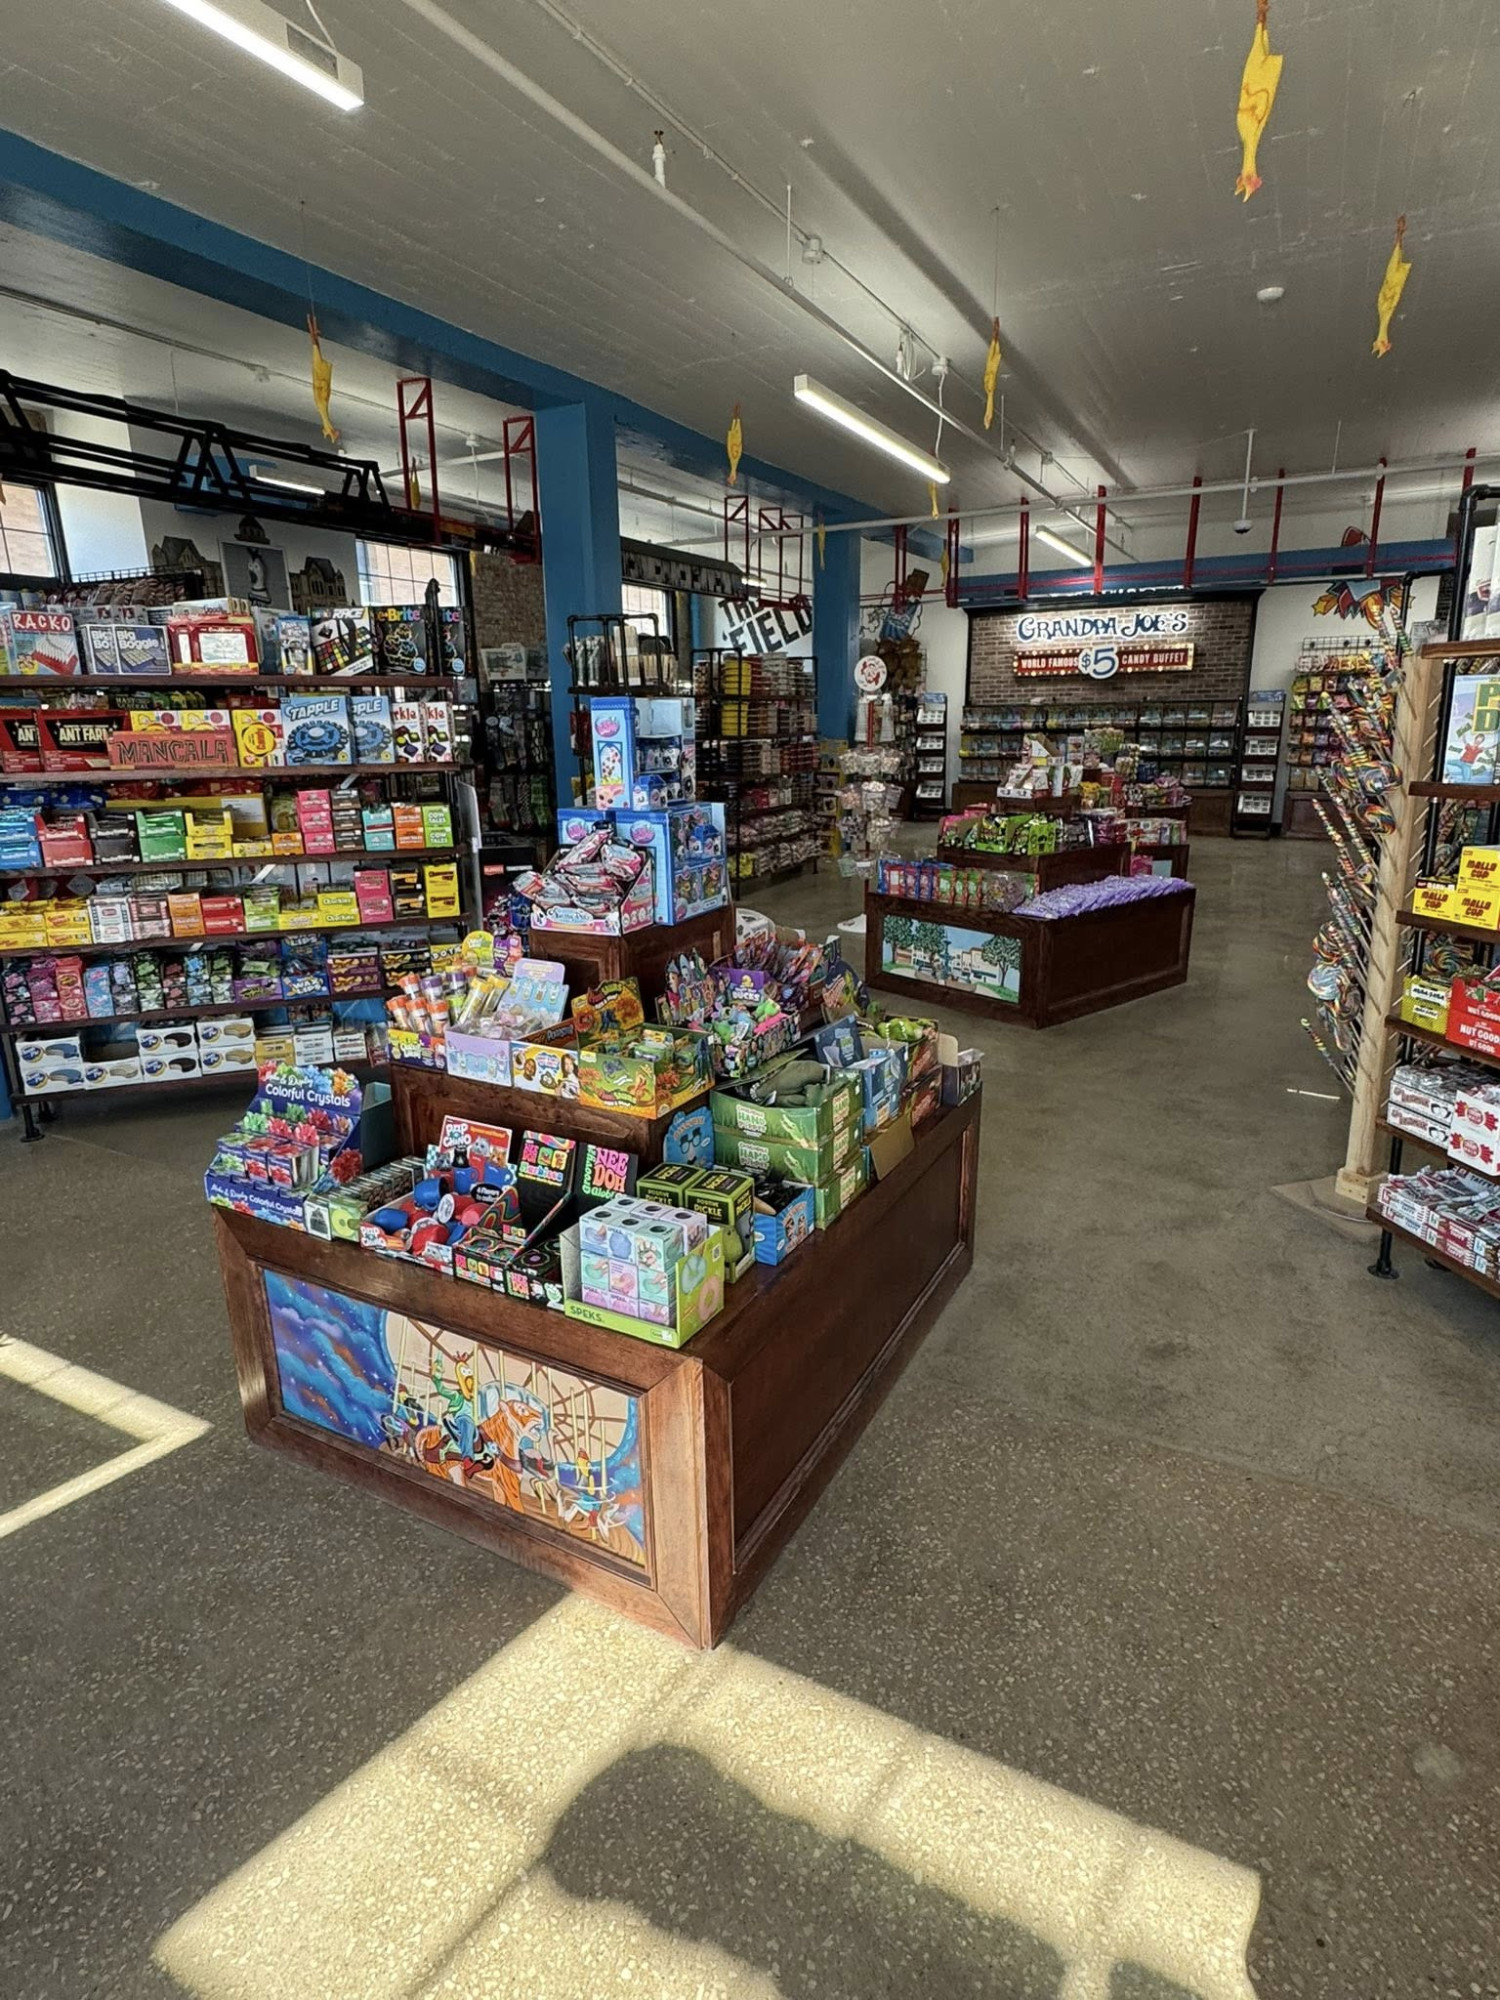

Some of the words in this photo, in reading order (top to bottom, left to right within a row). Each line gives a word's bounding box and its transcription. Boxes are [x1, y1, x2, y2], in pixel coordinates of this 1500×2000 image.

[332, 608, 364, 619] RACE
[1017, 616, 1117, 641] GRANDPA
[1121, 612, 1188, 637] JOE'S
[117, 630, 137, 642] Big
[119, 637, 159, 651] Boggle
[1021, 659, 1047, 669] WORLD
[1048, 657, 1078, 668] FAMOUS
[1081, 646, 1116, 677] $5
[1121, 654, 1150, 665] CANDY
[1152, 652, 1185, 664] BUFFET
[290, 698, 339, 721] TAPPLE
[59, 727, 81, 742] ANT
[115, 739, 229, 765] MANCALA
[1466, 860, 1498, 872] MALLO
[1470, 869, 1490, 879] CUP
[1421, 891, 1449, 903] MALLO
[1461, 897, 1492, 910] MALLO
[1425, 900, 1442, 909] CUP
[1465, 907, 1484, 917] CUP
[731, 991, 761, 1003] DUCKS
[1459, 1023, 1477, 1037] NUT
[265, 1083, 305, 1101] Colorful
[306, 1089, 351, 1108] Crystals
[595, 1146, 630, 1176] NEE
[592, 1163, 627, 1193] DOH
[249, 1193, 277, 1212] Colorful
[693, 1203, 723, 1218] PICKLE
